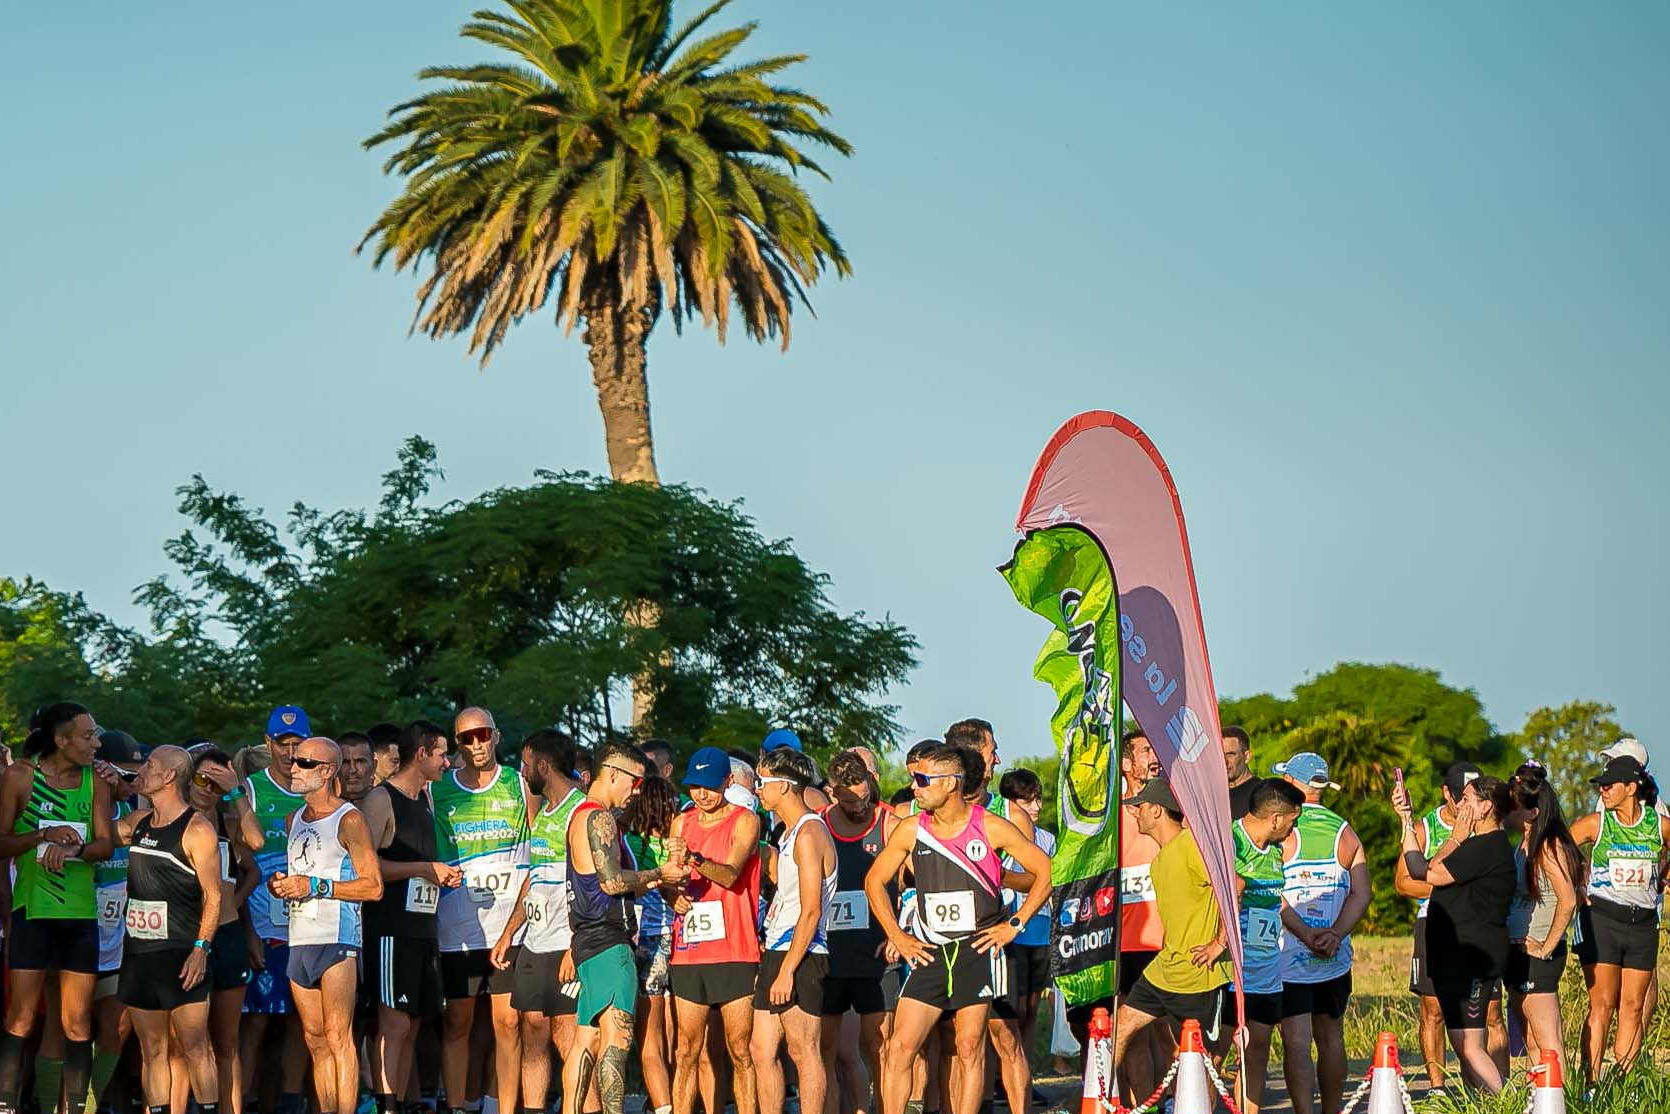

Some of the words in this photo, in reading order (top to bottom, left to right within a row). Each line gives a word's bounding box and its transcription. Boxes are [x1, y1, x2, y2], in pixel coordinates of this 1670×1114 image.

[473, 872, 511, 892] 107
[1615, 868, 1644, 884] 521
[127, 909, 162, 929] 530
[524, 901, 542, 921] 06
[831, 902, 855, 921] 71
[936, 904, 960, 922] 98
[687, 914, 712, 932] 45
[1259, 919, 1278, 938] 74
